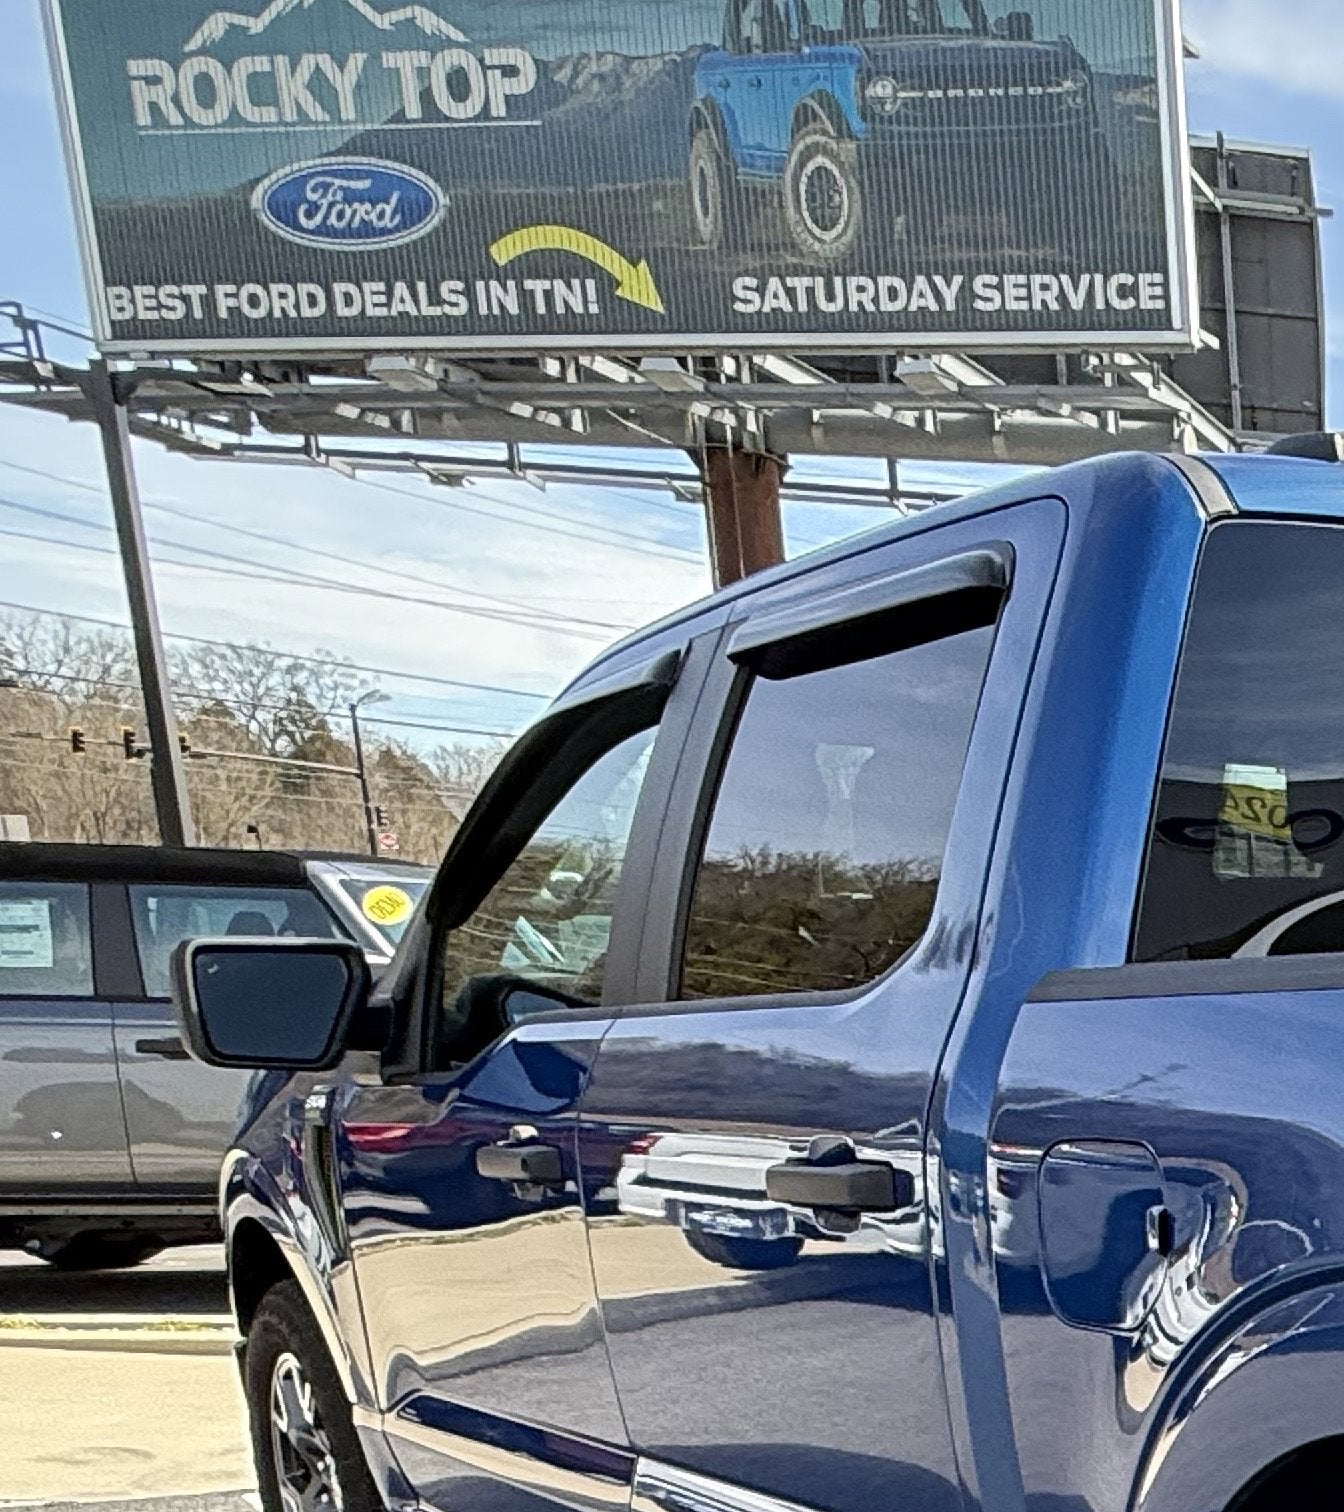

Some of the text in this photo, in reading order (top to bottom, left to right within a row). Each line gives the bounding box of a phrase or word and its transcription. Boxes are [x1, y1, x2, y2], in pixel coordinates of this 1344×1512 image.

[127, 47, 538, 127] ROCKY TOP
[298, 175, 402, 231] Ford
[110, 278, 600, 321] BEST FORD DEALS IN TN!
[732, 271, 1166, 313] SATURDAY SERVICE
